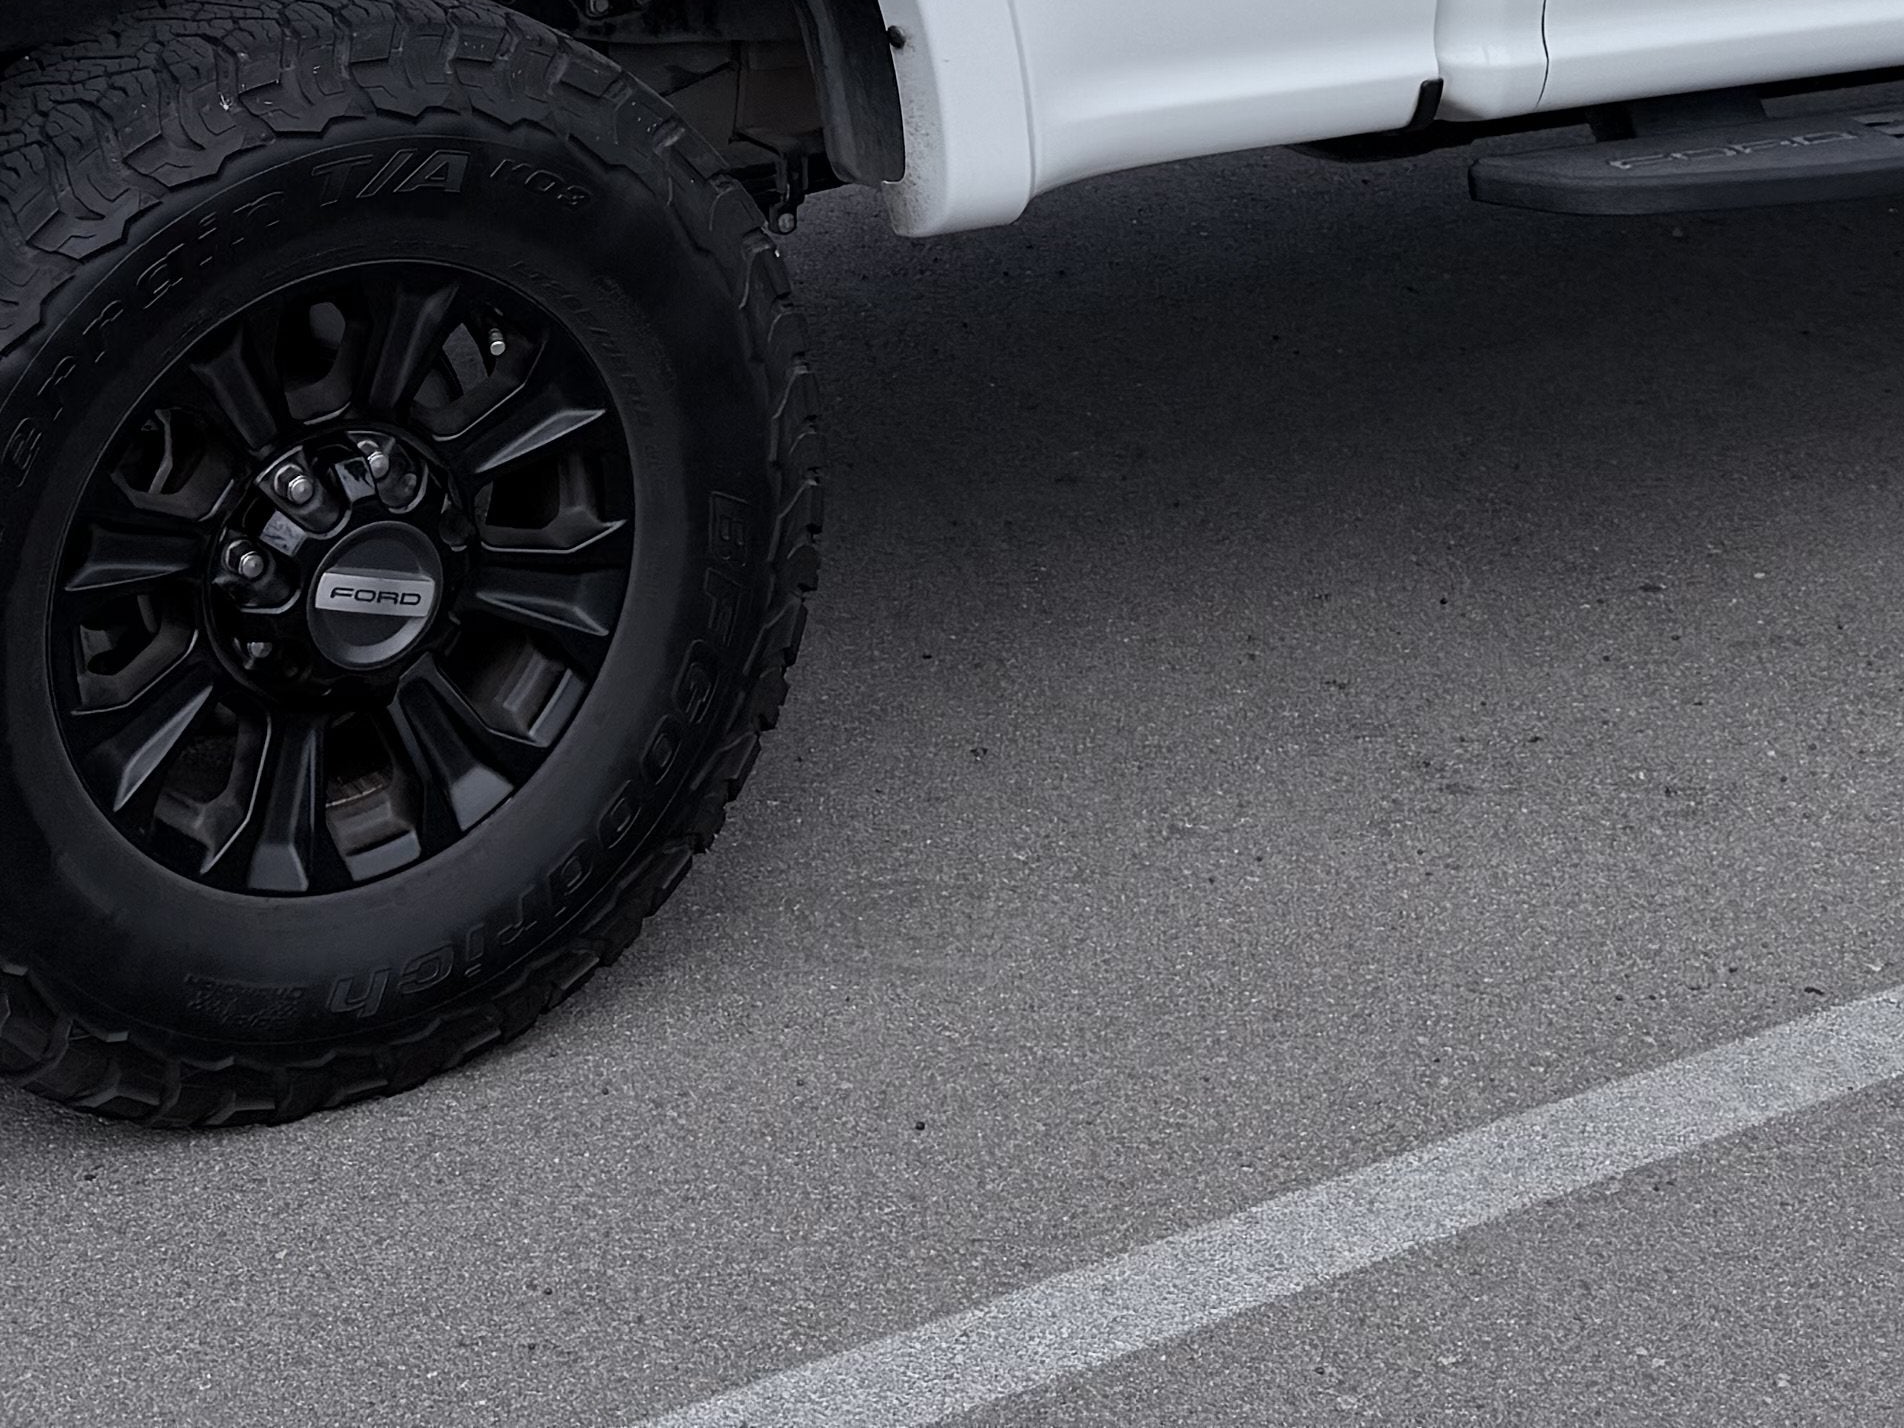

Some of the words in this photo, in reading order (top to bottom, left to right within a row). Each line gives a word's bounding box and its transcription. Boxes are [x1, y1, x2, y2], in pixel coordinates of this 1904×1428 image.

[1607, 130, 1859, 169] FORD
[311, 147, 472, 209] T/A
[329, 586, 422, 606] FORD
